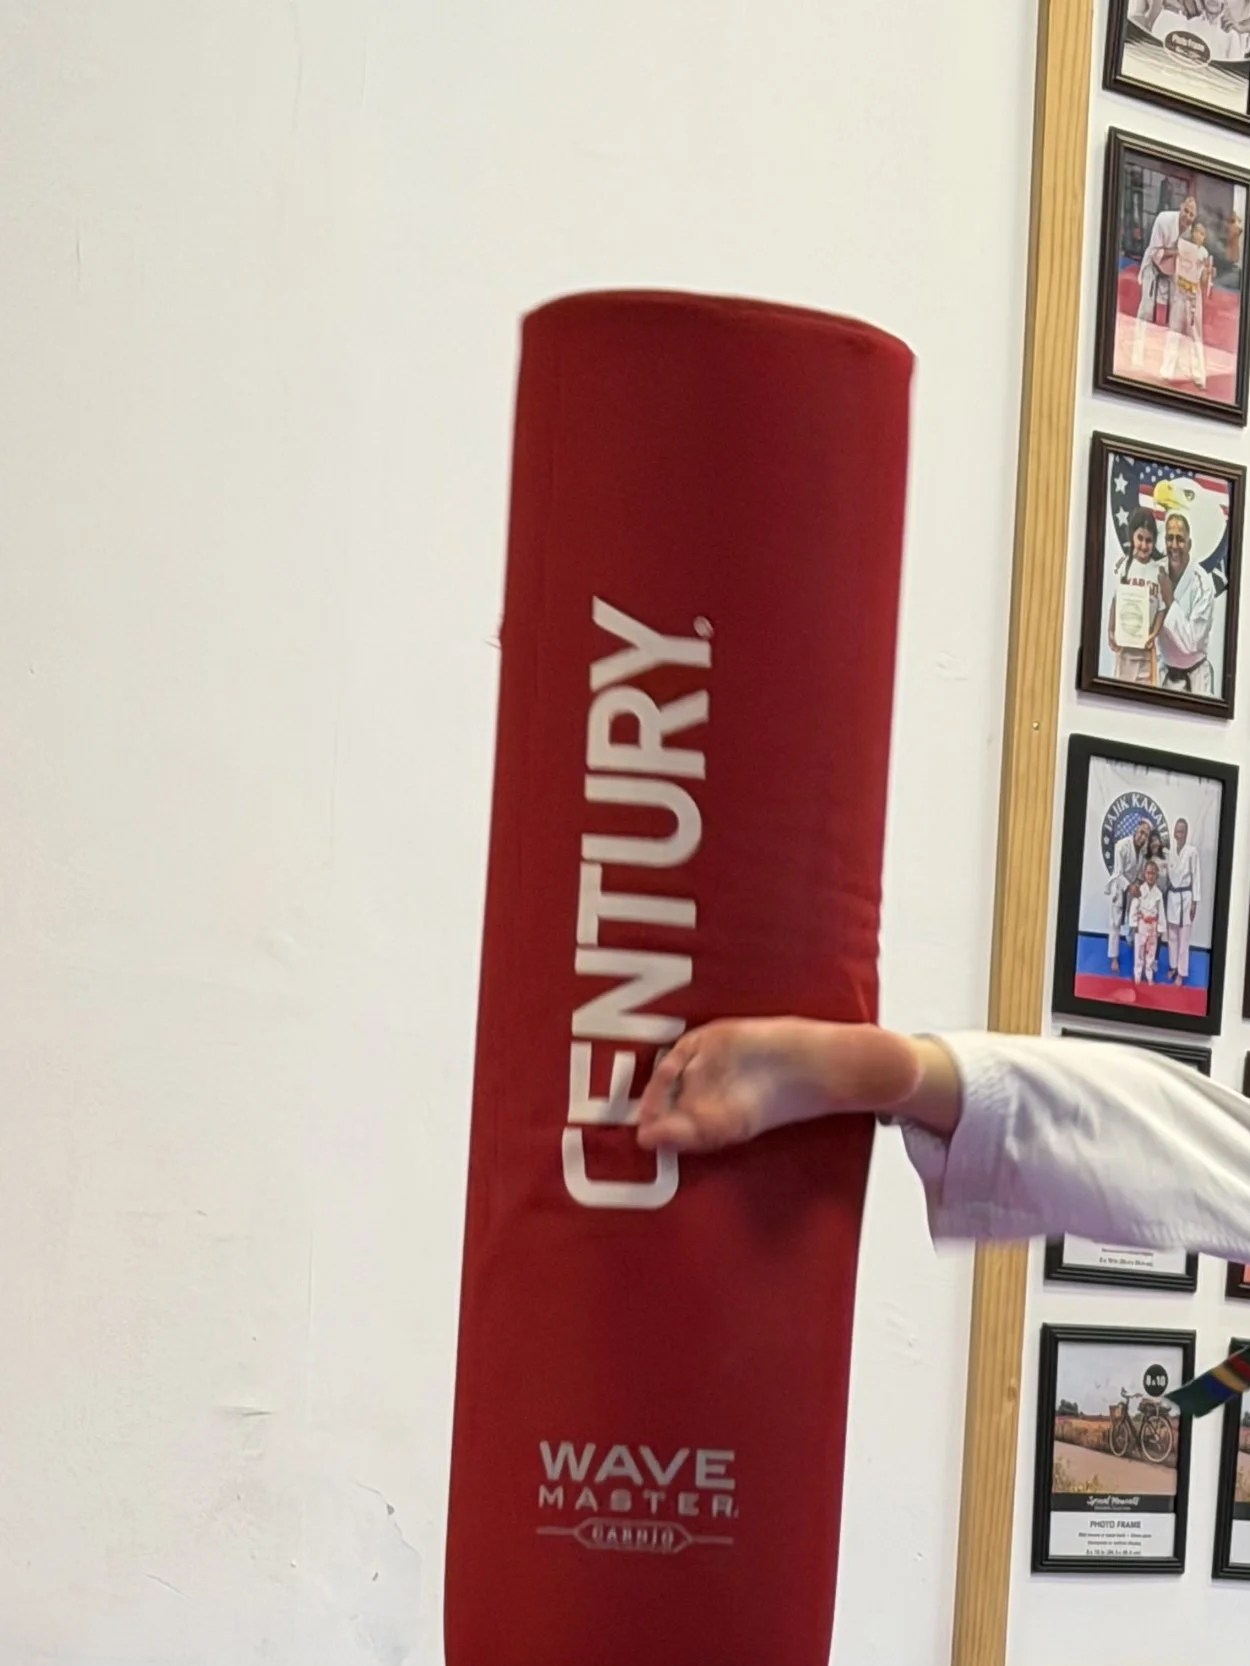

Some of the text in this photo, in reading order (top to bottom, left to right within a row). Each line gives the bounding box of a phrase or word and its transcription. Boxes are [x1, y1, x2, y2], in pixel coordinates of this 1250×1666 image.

[1131, 793, 1169, 843] KARATE
[562, 595, 712, 1210] CENTURY
[539, 1440, 736, 1490] WAVE
[538, 1484, 735, 1519] MASTER
[1089, 1520, 1141, 1529] PHOTO FRAME
